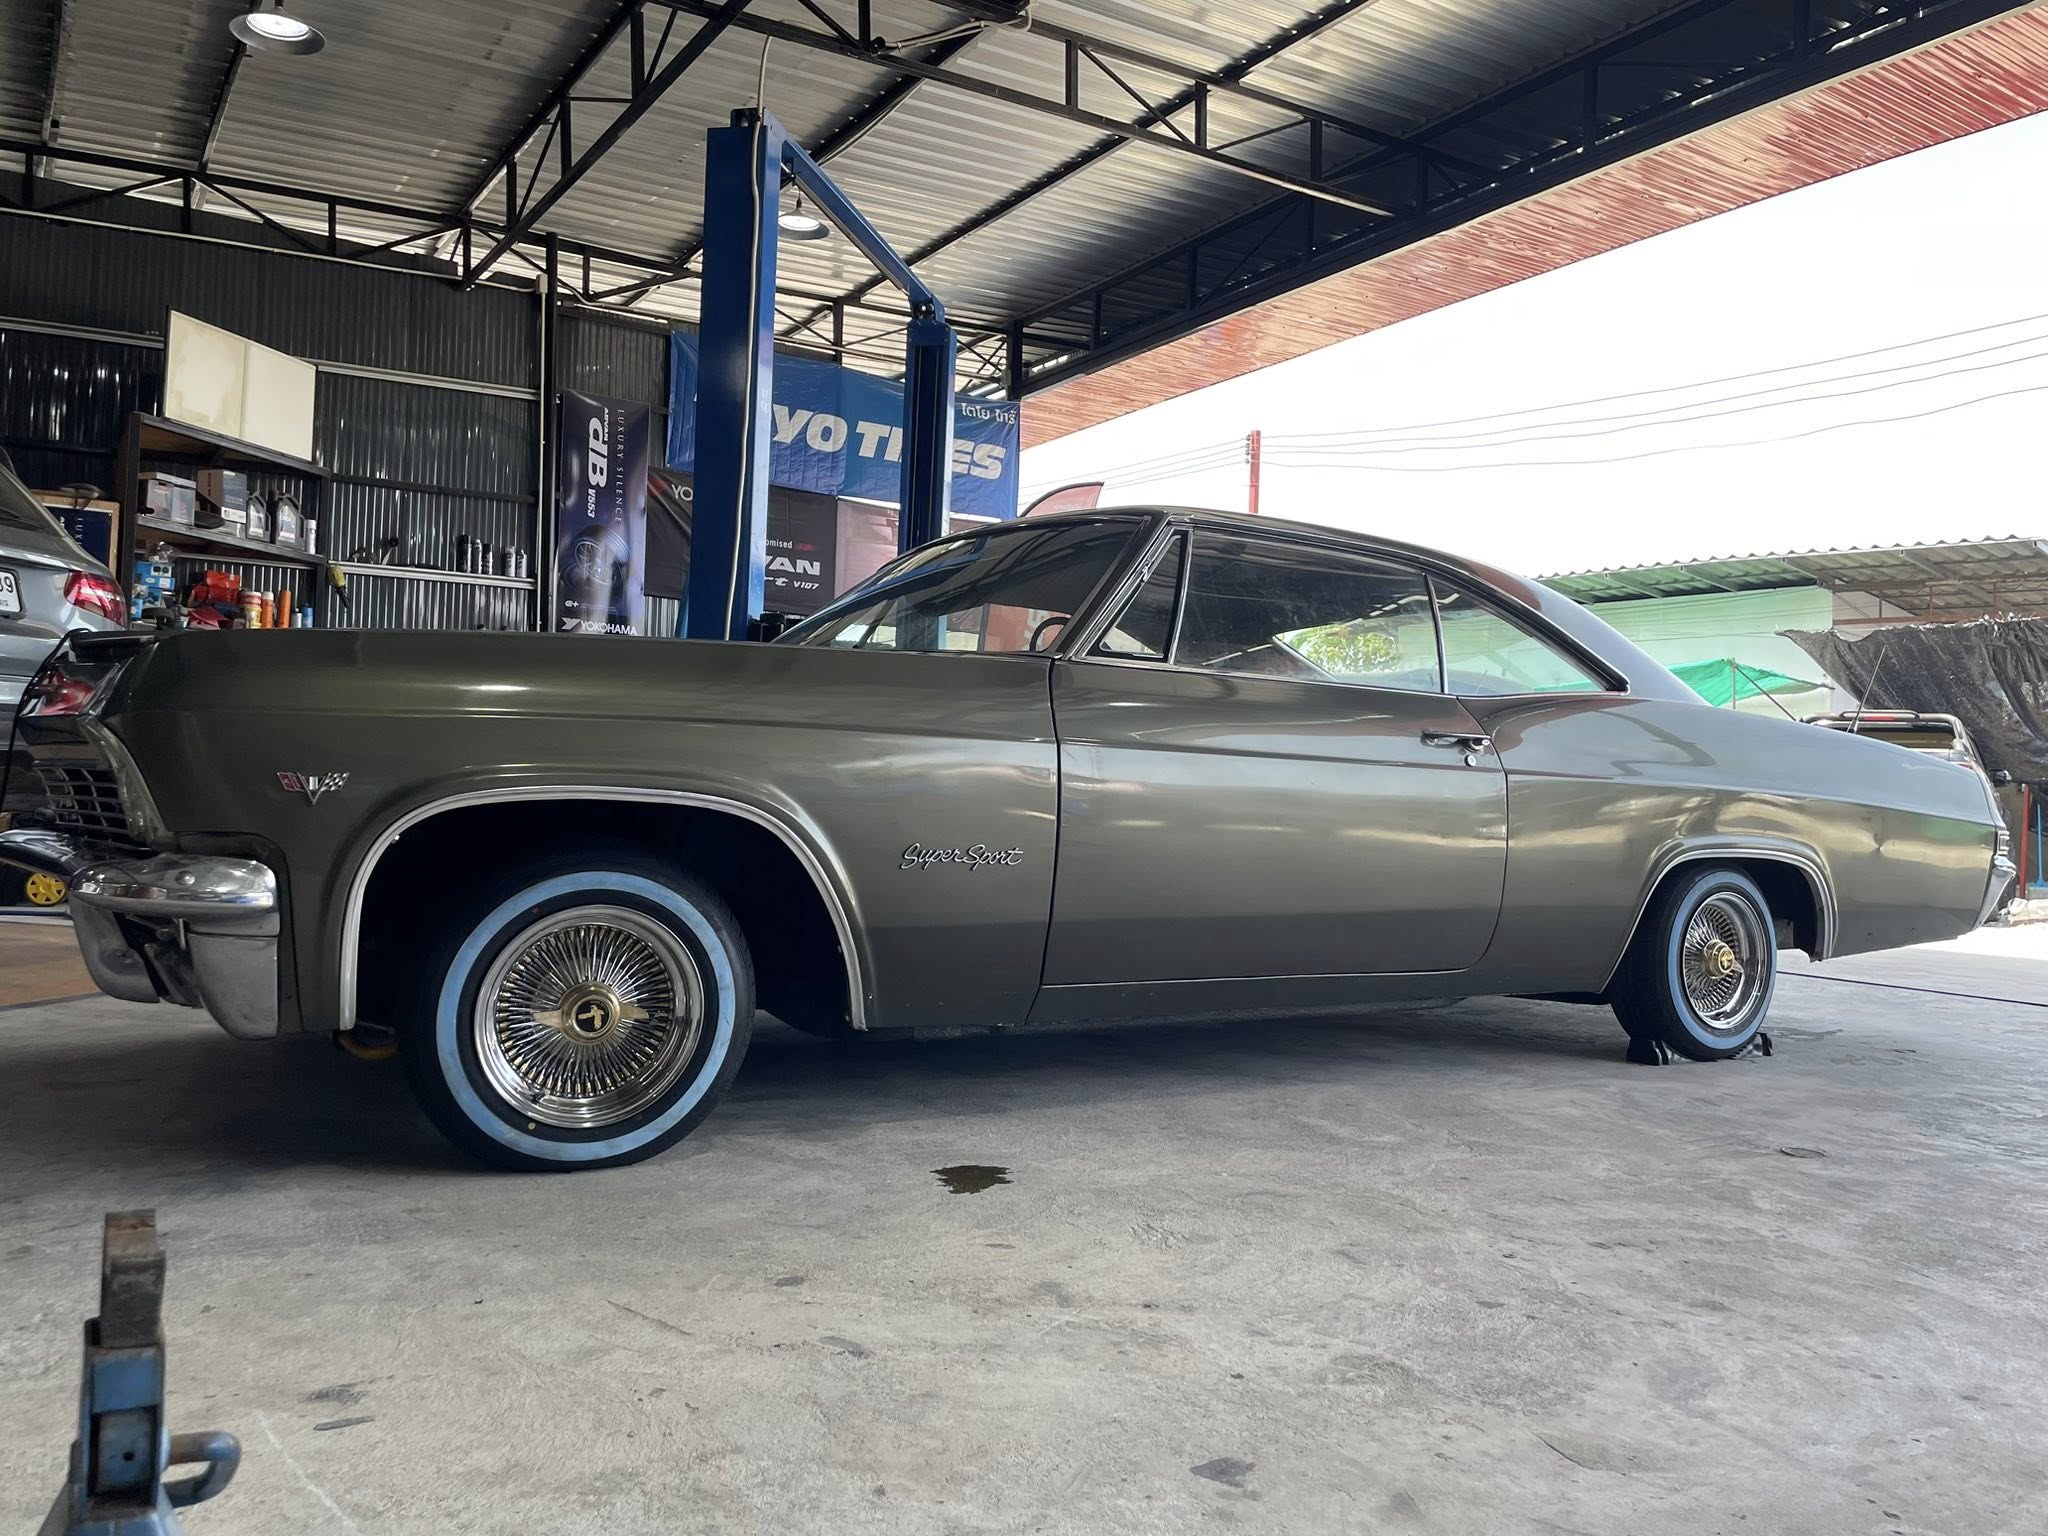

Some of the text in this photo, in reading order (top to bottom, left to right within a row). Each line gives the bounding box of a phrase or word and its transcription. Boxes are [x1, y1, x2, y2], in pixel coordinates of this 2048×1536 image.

[961, 403, 990, 420] โตโย
[855, 420, 1007, 480] TIES
[587, 417, 608, 518] dB V553
[615, 409, 625, 521] LUXURY SILENCE
[793, 580, 820, 590] V107
[581, 620, 638, 636] YOKOHAMA
[901, 842, 1023, 871] Super Sport
